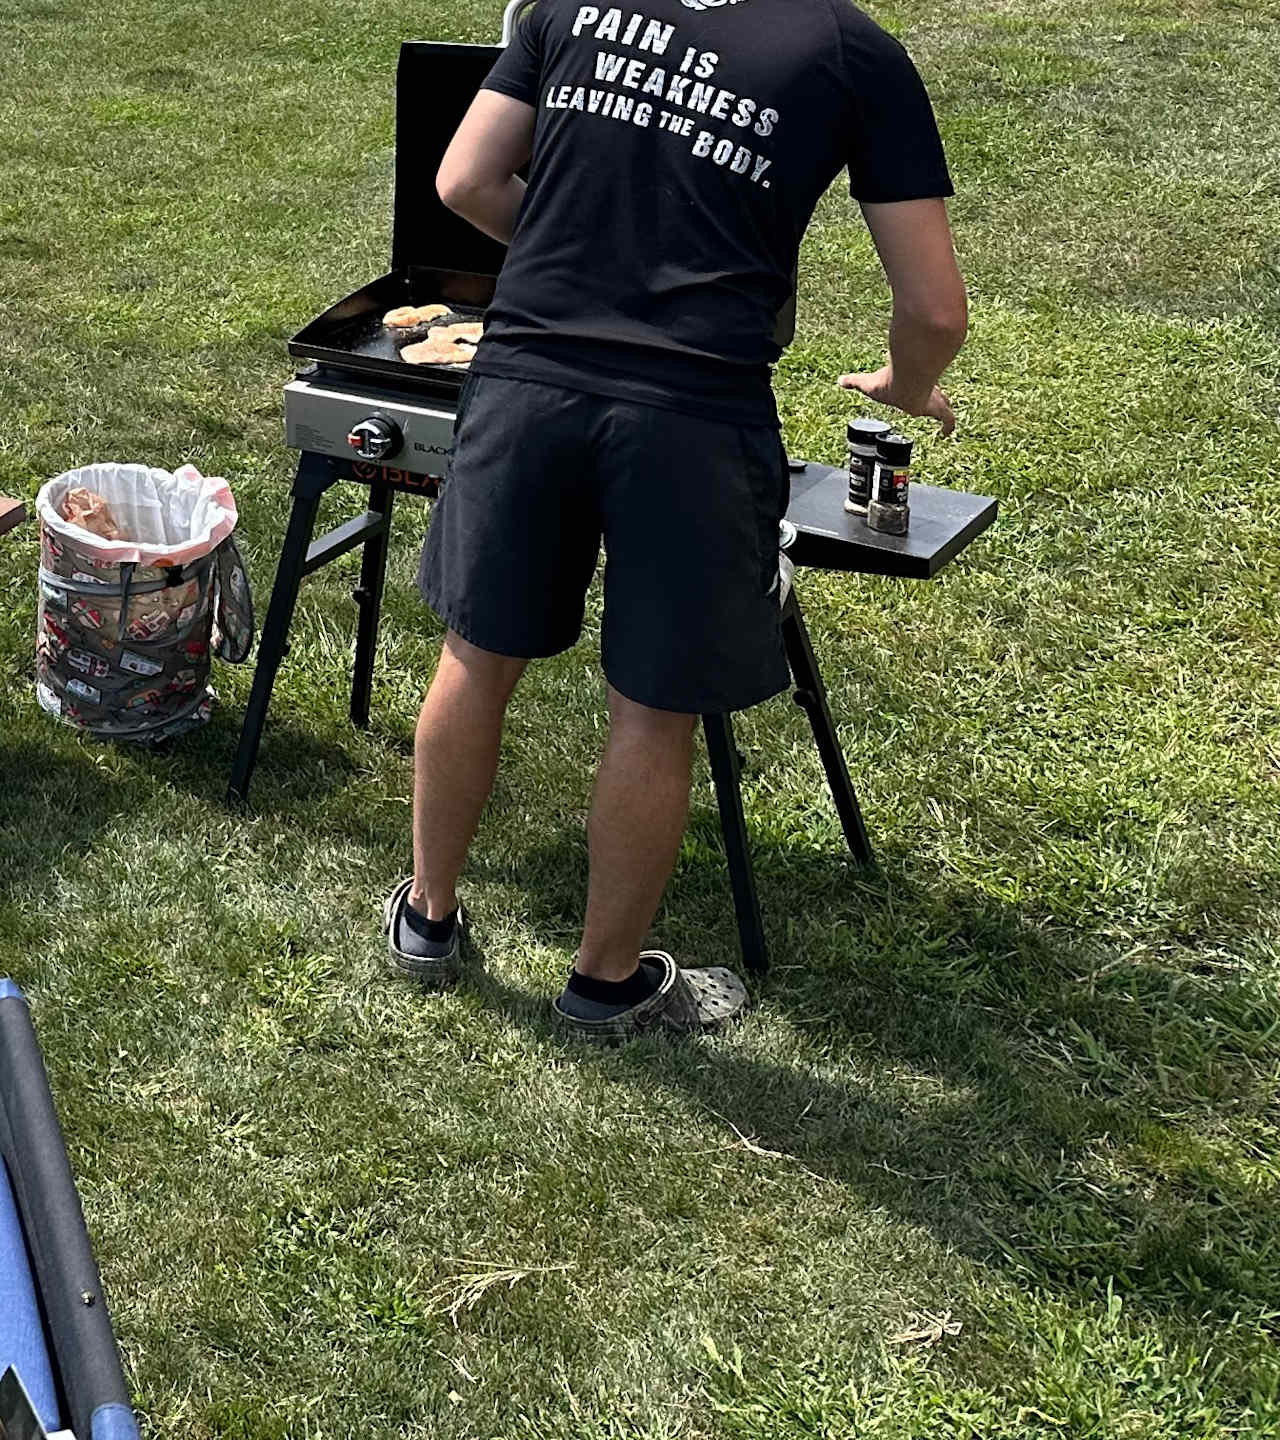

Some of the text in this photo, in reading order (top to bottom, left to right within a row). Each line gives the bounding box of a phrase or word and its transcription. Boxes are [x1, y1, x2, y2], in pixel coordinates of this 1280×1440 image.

[571, 5, 719, 79] PAIN IS
[545, 85, 773, 189] LEAVING THE BODY.
[594, 51, 780, 137] WEAKNESS
